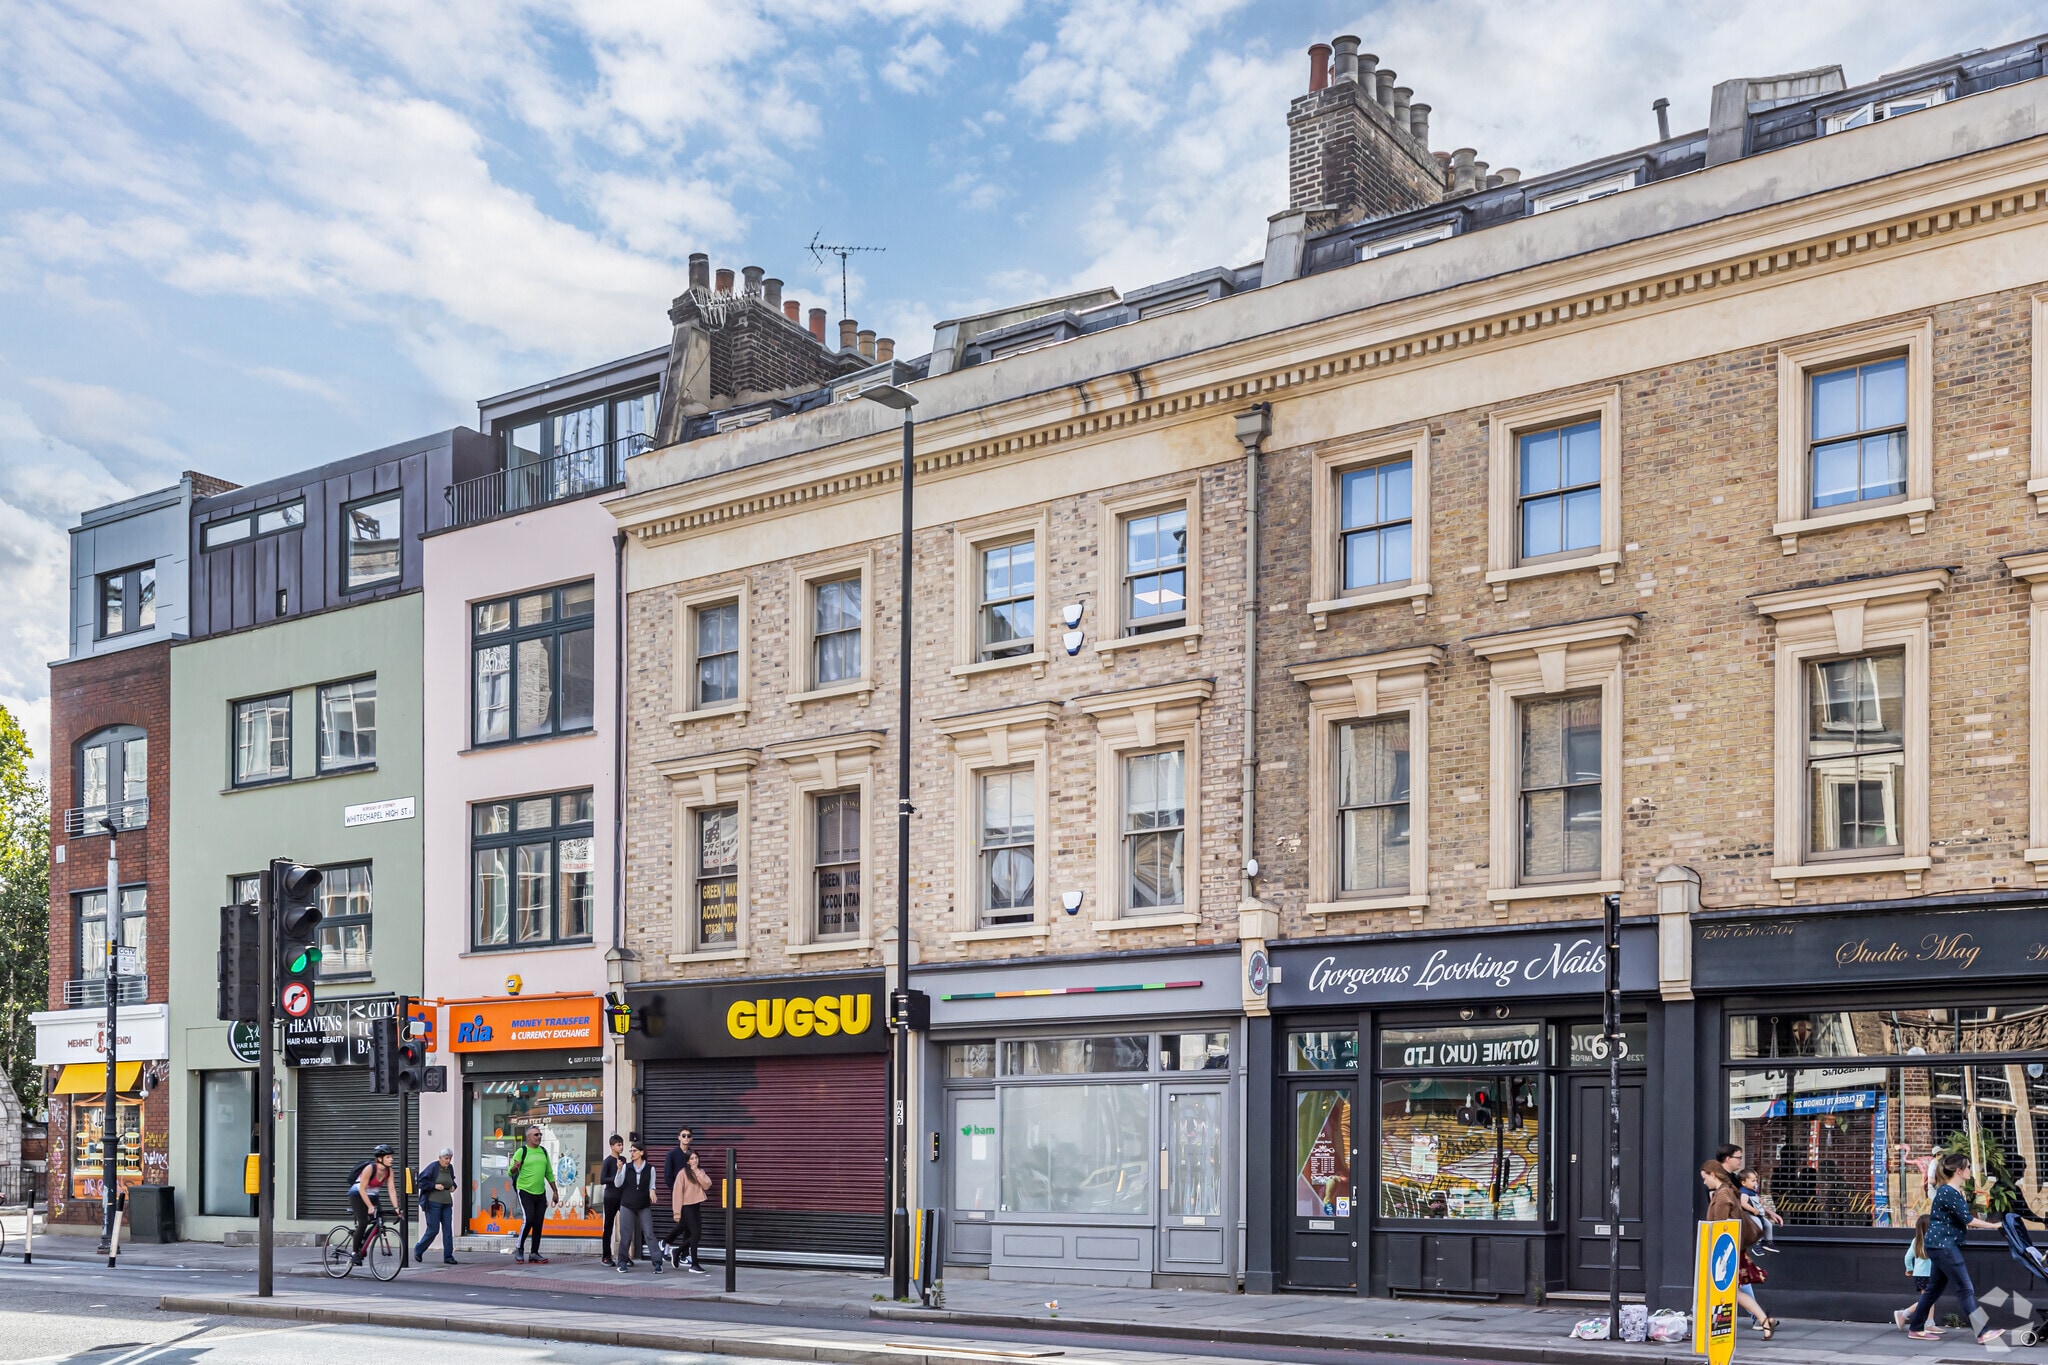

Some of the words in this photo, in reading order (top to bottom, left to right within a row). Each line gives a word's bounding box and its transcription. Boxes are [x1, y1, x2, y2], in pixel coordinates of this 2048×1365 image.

[346, 812, 383, 823] WHITECHAPEL
[385, 809, 398, 818] HIGH
[820, 872, 840, 888] GREEN
[703, 884, 721, 899] GREEN
[821, 892, 860, 909] ACCOUNTAN
[702, 902, 737, 919] ACCOUNTAN
[1835, 938, 1909, 969] Studio
[1916, 933, 1982, 970] Mag
[1308, 956, 1410, 994] Gorgeous
[1413, 950, 1518, 990] Looking
[1524, 939, 1607, 980] Nails
[368, 1002, 397, 1018] CITY
[726, 994, 872, 1040] GUGSU
[289, 1016, 342, 1034] HEAVENS
[458, 1014, 494, 1044] Ria
[511, 1020, 541, 1028] MONEY
[545, 1016, 590, 1026] TRANSFER
[68, 1038, 93, 1048] MEHMET
[116, 1036, 131, 1045] ENDI
[322, 1035, 345, 1044] BEAUTY
[511, 1032, 516, 1040] &
[518, 1030, 552, 1040] CURRENCY
[553, 1028, 590, 1038] EXCHANGE
[1302, 1044, 1336, 1060] 66A
[548, 1104, 593, 1115] INR-96.00
[974, 1125, 995, 1135] bam
[1772, 1192, 1826, 1213] Studio
[1836, 1190, 1890, 1220] Mag
[486, 1222, 500, 1232] Ria
